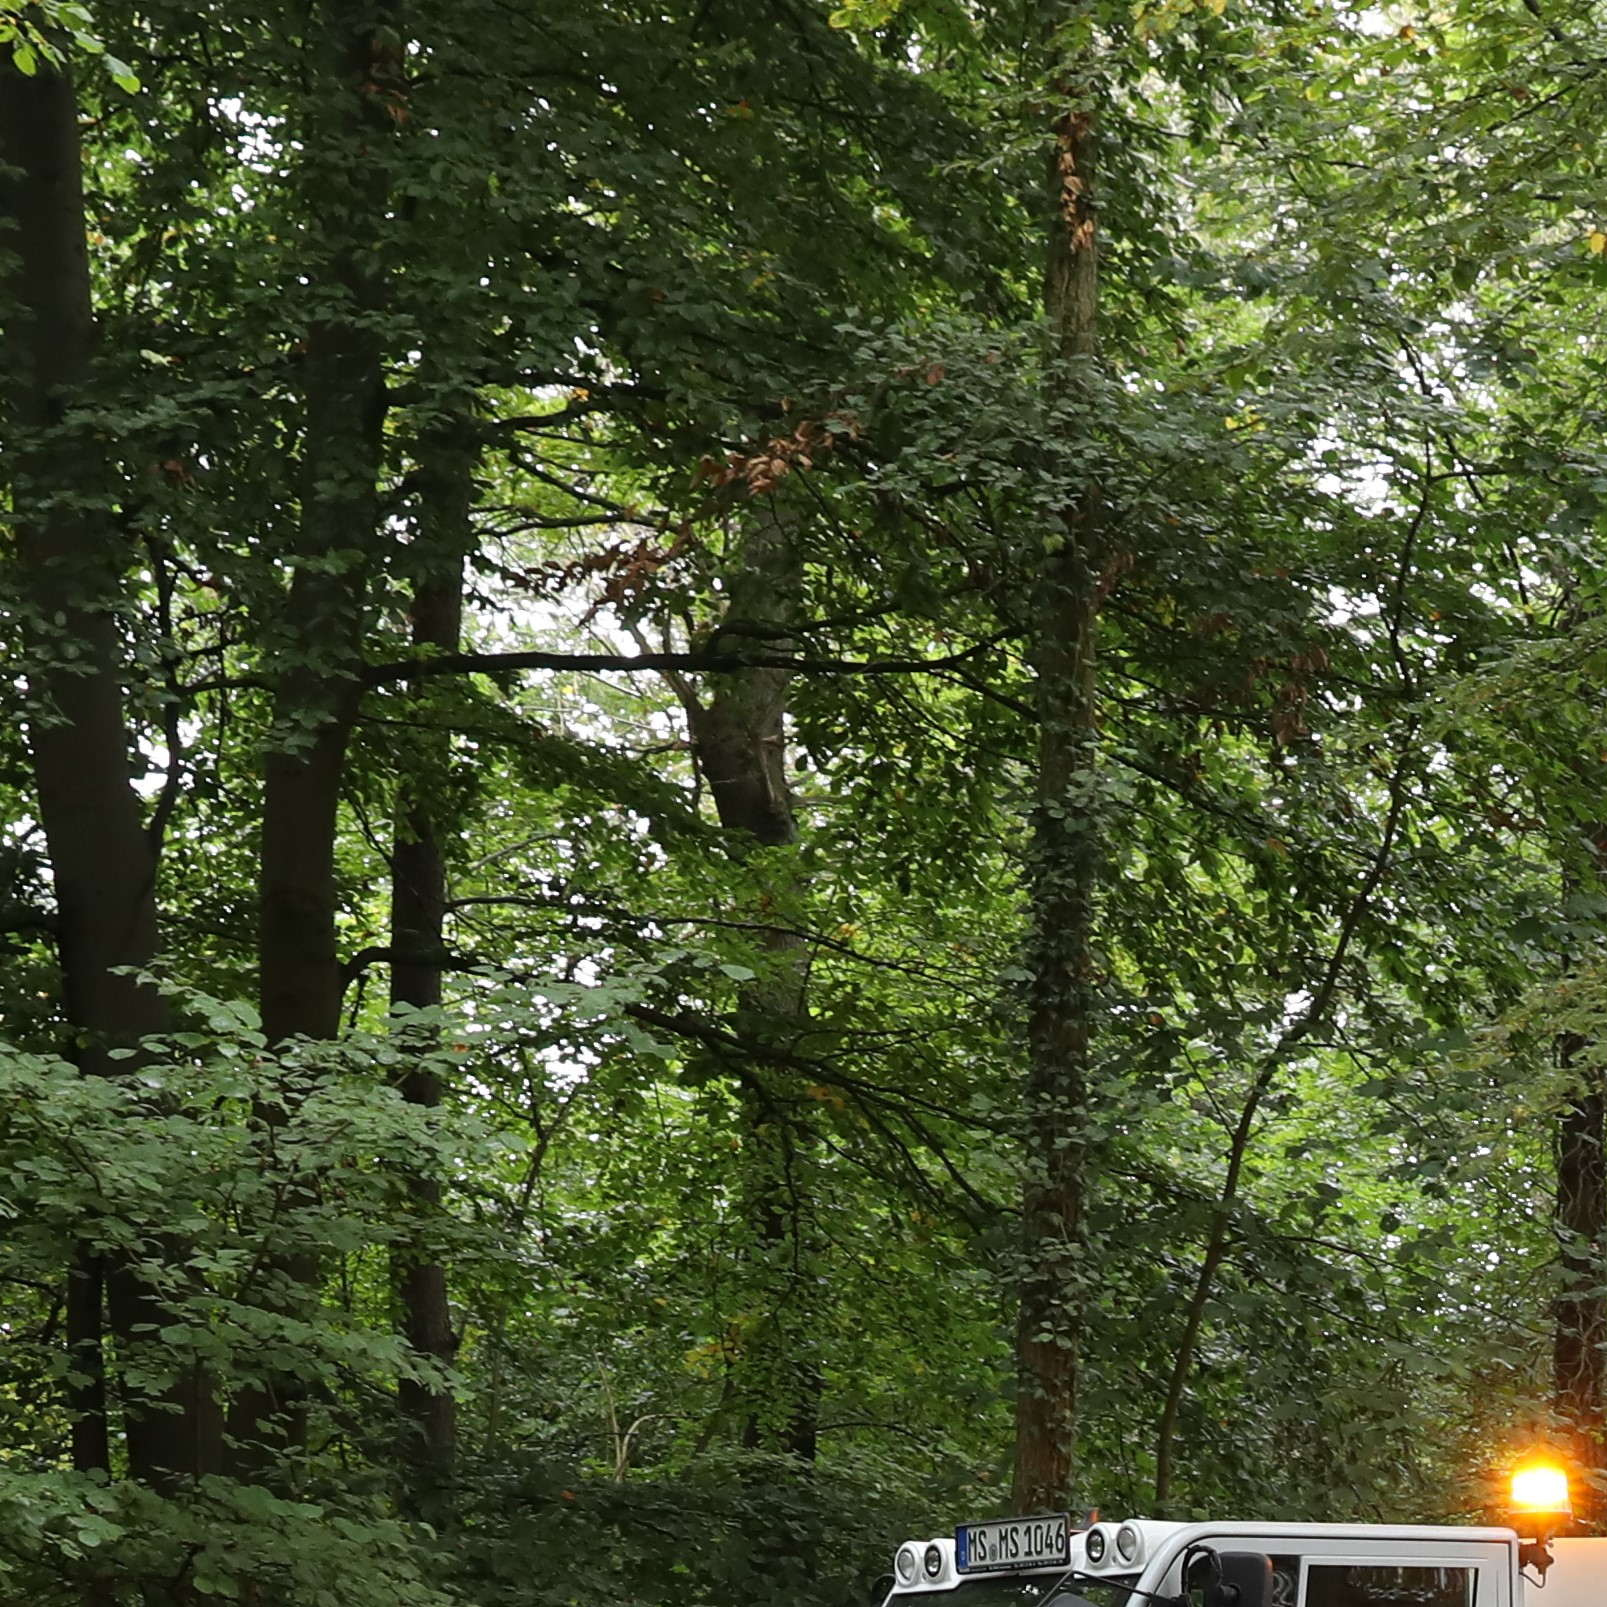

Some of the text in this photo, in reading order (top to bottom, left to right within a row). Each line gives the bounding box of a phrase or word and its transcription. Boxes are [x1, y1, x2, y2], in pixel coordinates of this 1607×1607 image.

[968, 1522, 1065, 1562] MS MS 1046
